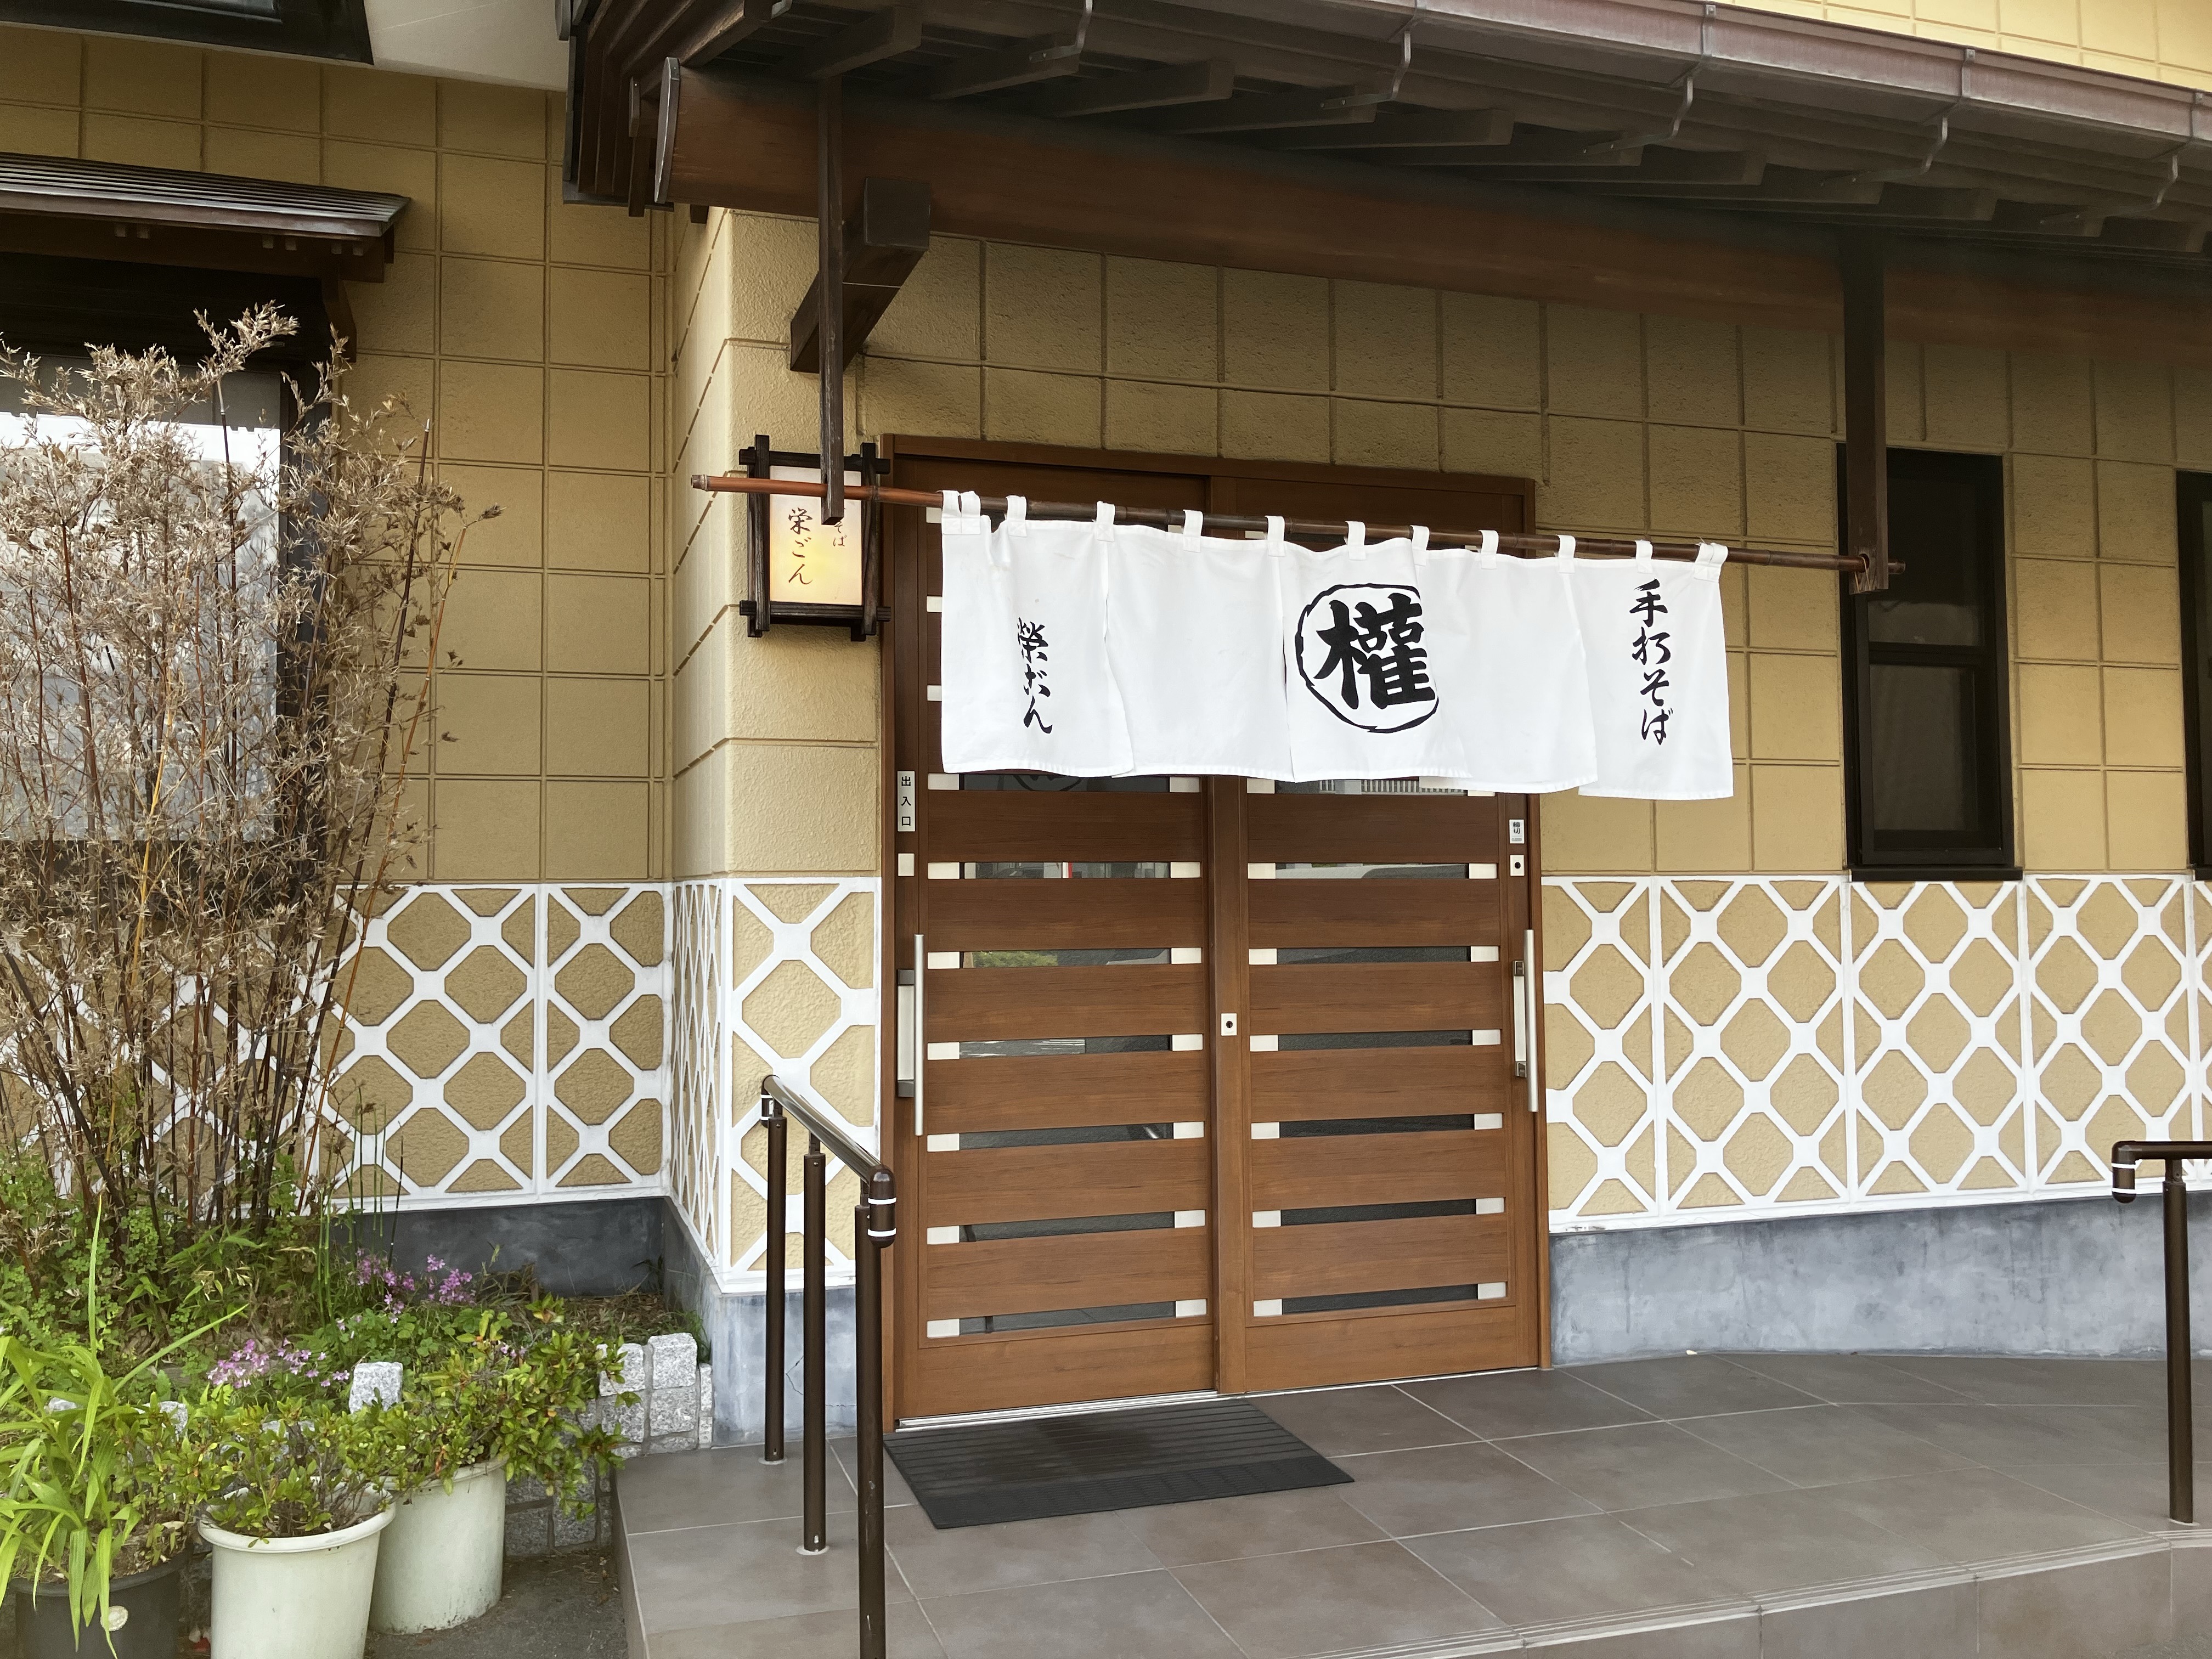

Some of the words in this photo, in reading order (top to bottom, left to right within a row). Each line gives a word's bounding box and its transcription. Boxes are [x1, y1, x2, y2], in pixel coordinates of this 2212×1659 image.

[788, 506, 814, 585] 栄ごん
[901, 776, 911, 826] 出入口
